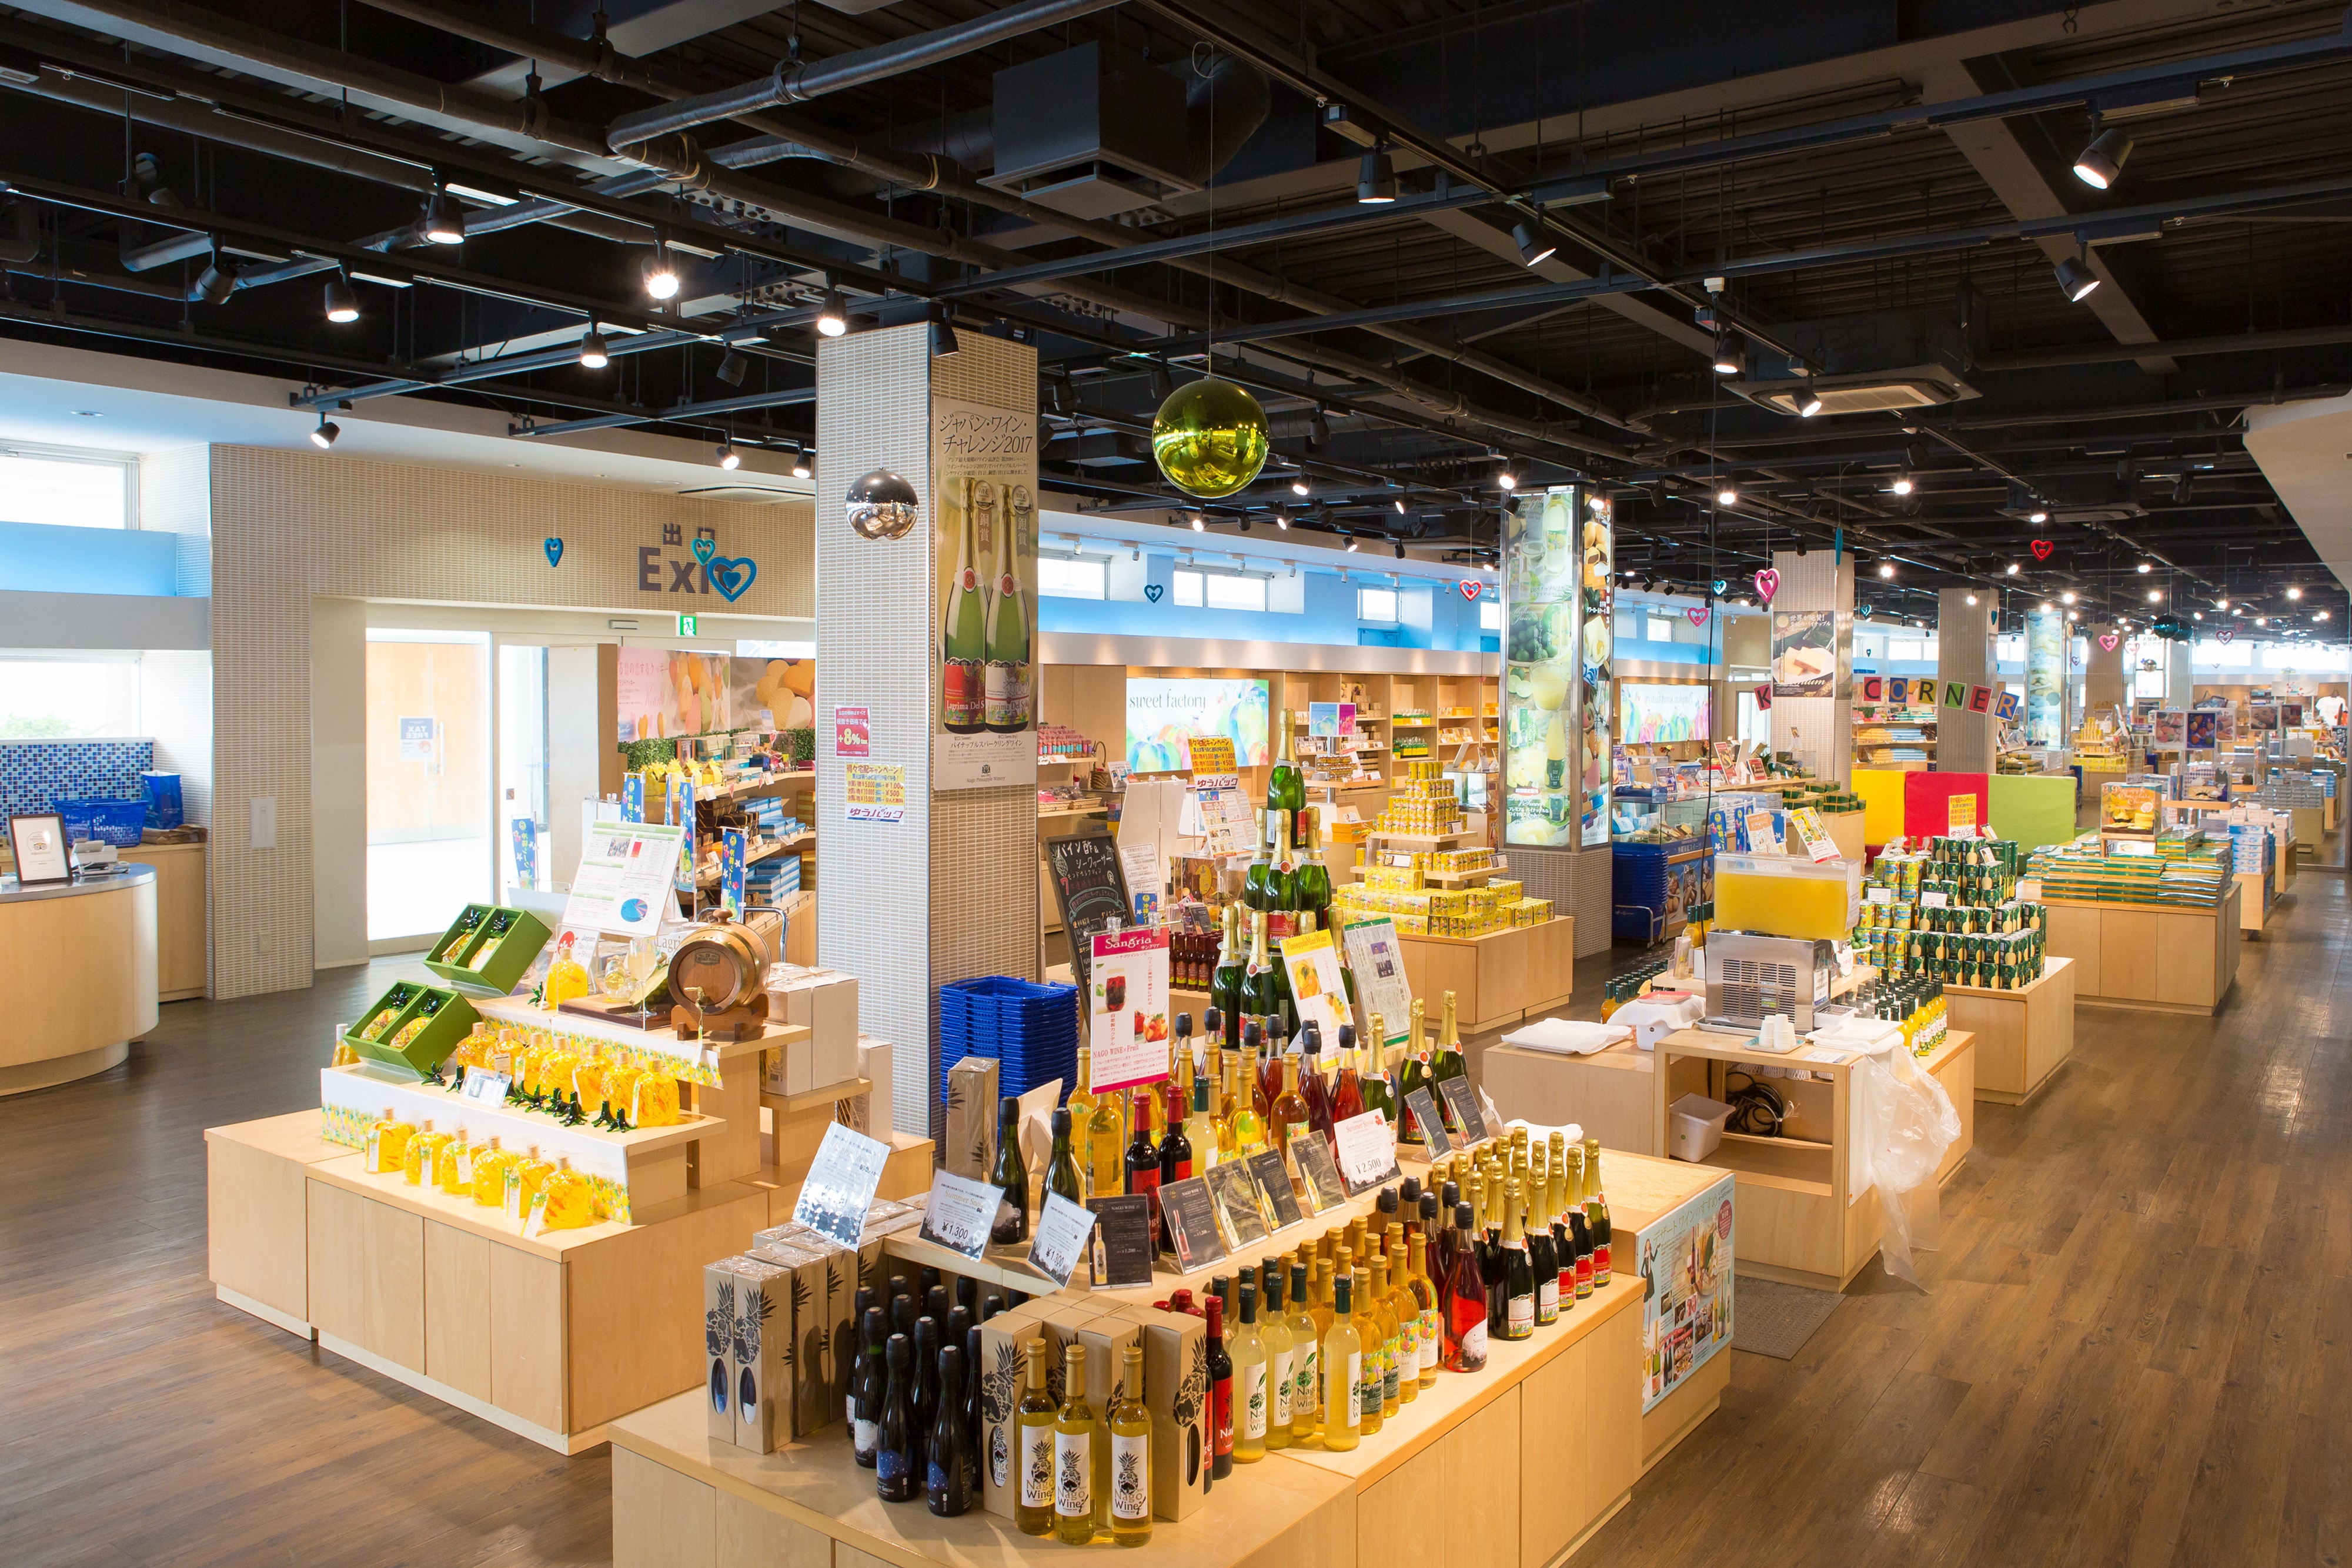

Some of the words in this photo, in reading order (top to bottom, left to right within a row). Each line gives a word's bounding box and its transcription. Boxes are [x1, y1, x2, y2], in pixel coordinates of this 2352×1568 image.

[943, 433, 1033, 454] チャレンジ2017
[980, 513, 989, 542] 銅賞
[1018, 517, 1027, 546] 銀賞
[1130, 694, 1162, 709] sweet
[1167, 688, 1205, 713] factory
[1865, 679, 2015, 717] CORNER
[947, 700, 968, 712] Lagrima
[1197, 777, 1238, 788] ゆうパック
[850, 808, 904, 819] ゆうパック
[657, 935, 680, 955] Lagri
[1105, 937, 1151, 949] Sangria
[1093, 1049, 1108, 1059] NAGO
[1356, 1158, 1381, 1174] ¥2,500
[944, 1189, 969, 1204] Summer
[970, 1198, 984, 1208] Snow
[942, 1221, 968, 1239] ¥1,300
[1046, 1247, 1064, 1267] ¥1,300
[1027, 1479, 1055, 1490] Nago
[1027, 1489, 1051, 1499] Wine
[1058, 1487, 1085, 1500] Nago
[1114, 1489, 1142, 1503] Nago
[1058, 1497, 1081, 1509] Wine
[1115, 1499, 1138, 1510] Wine
